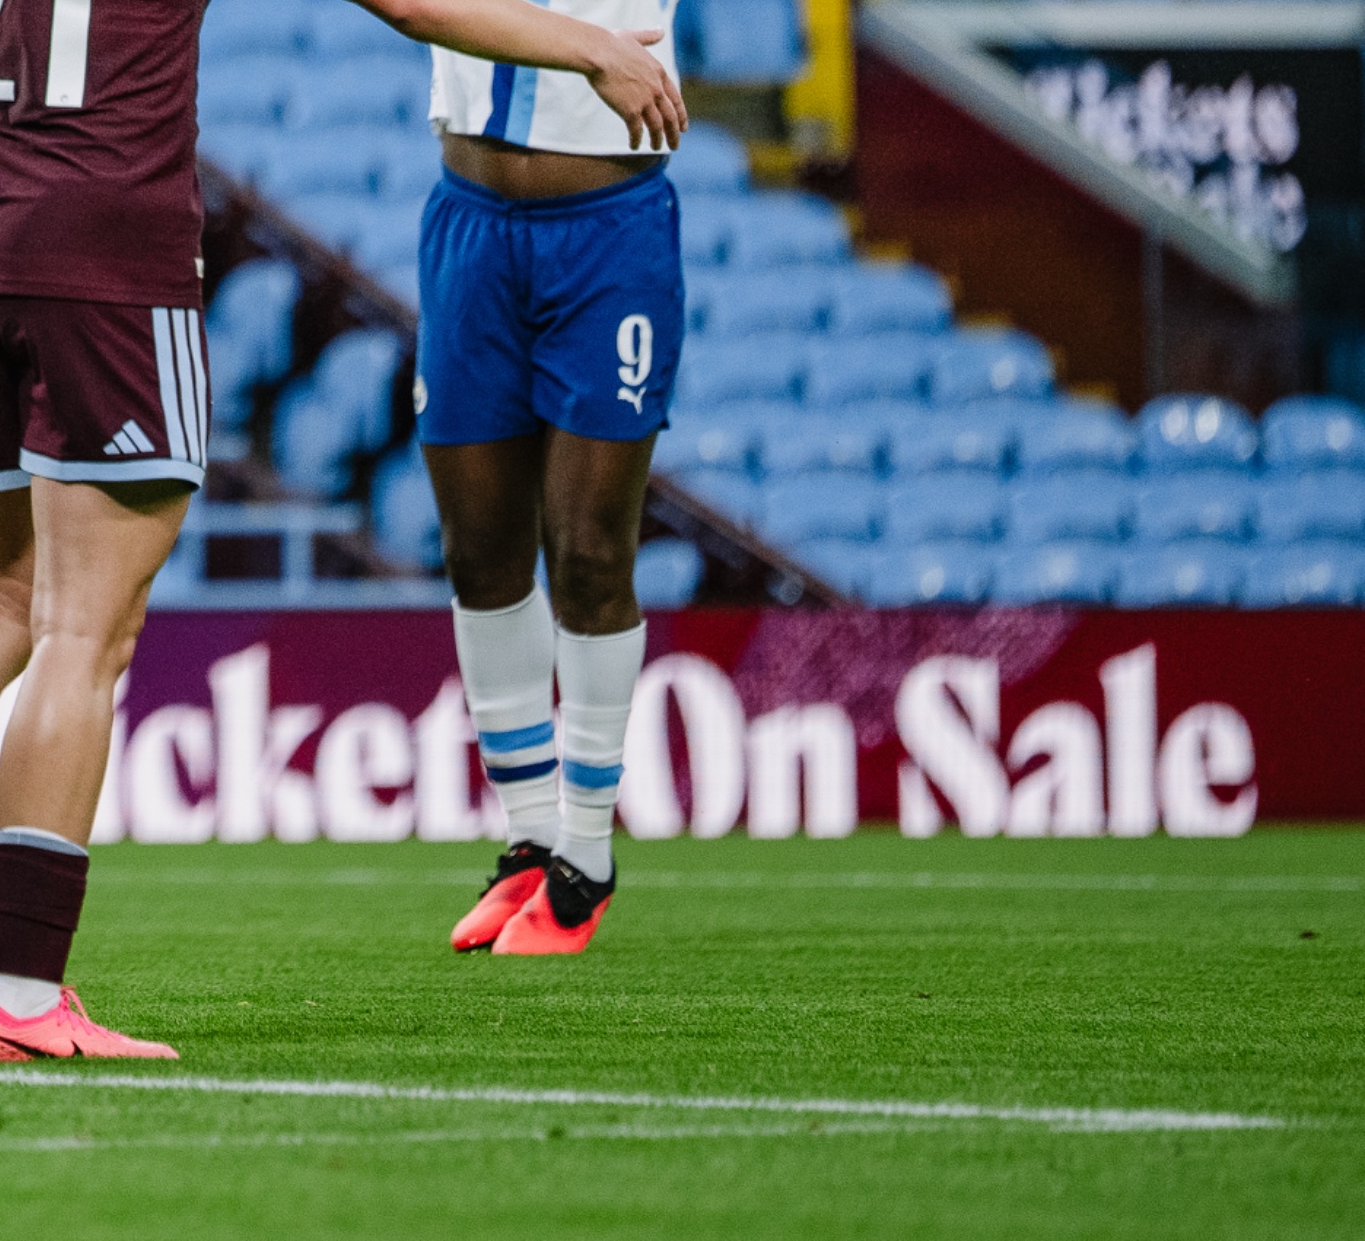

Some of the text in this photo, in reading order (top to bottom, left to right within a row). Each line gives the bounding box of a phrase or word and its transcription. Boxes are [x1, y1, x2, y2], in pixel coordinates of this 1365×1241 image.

[615, 313, 654, 388] 9
[617, 651, 860, 840] On
[894, 642, 1258, 840] Sale
